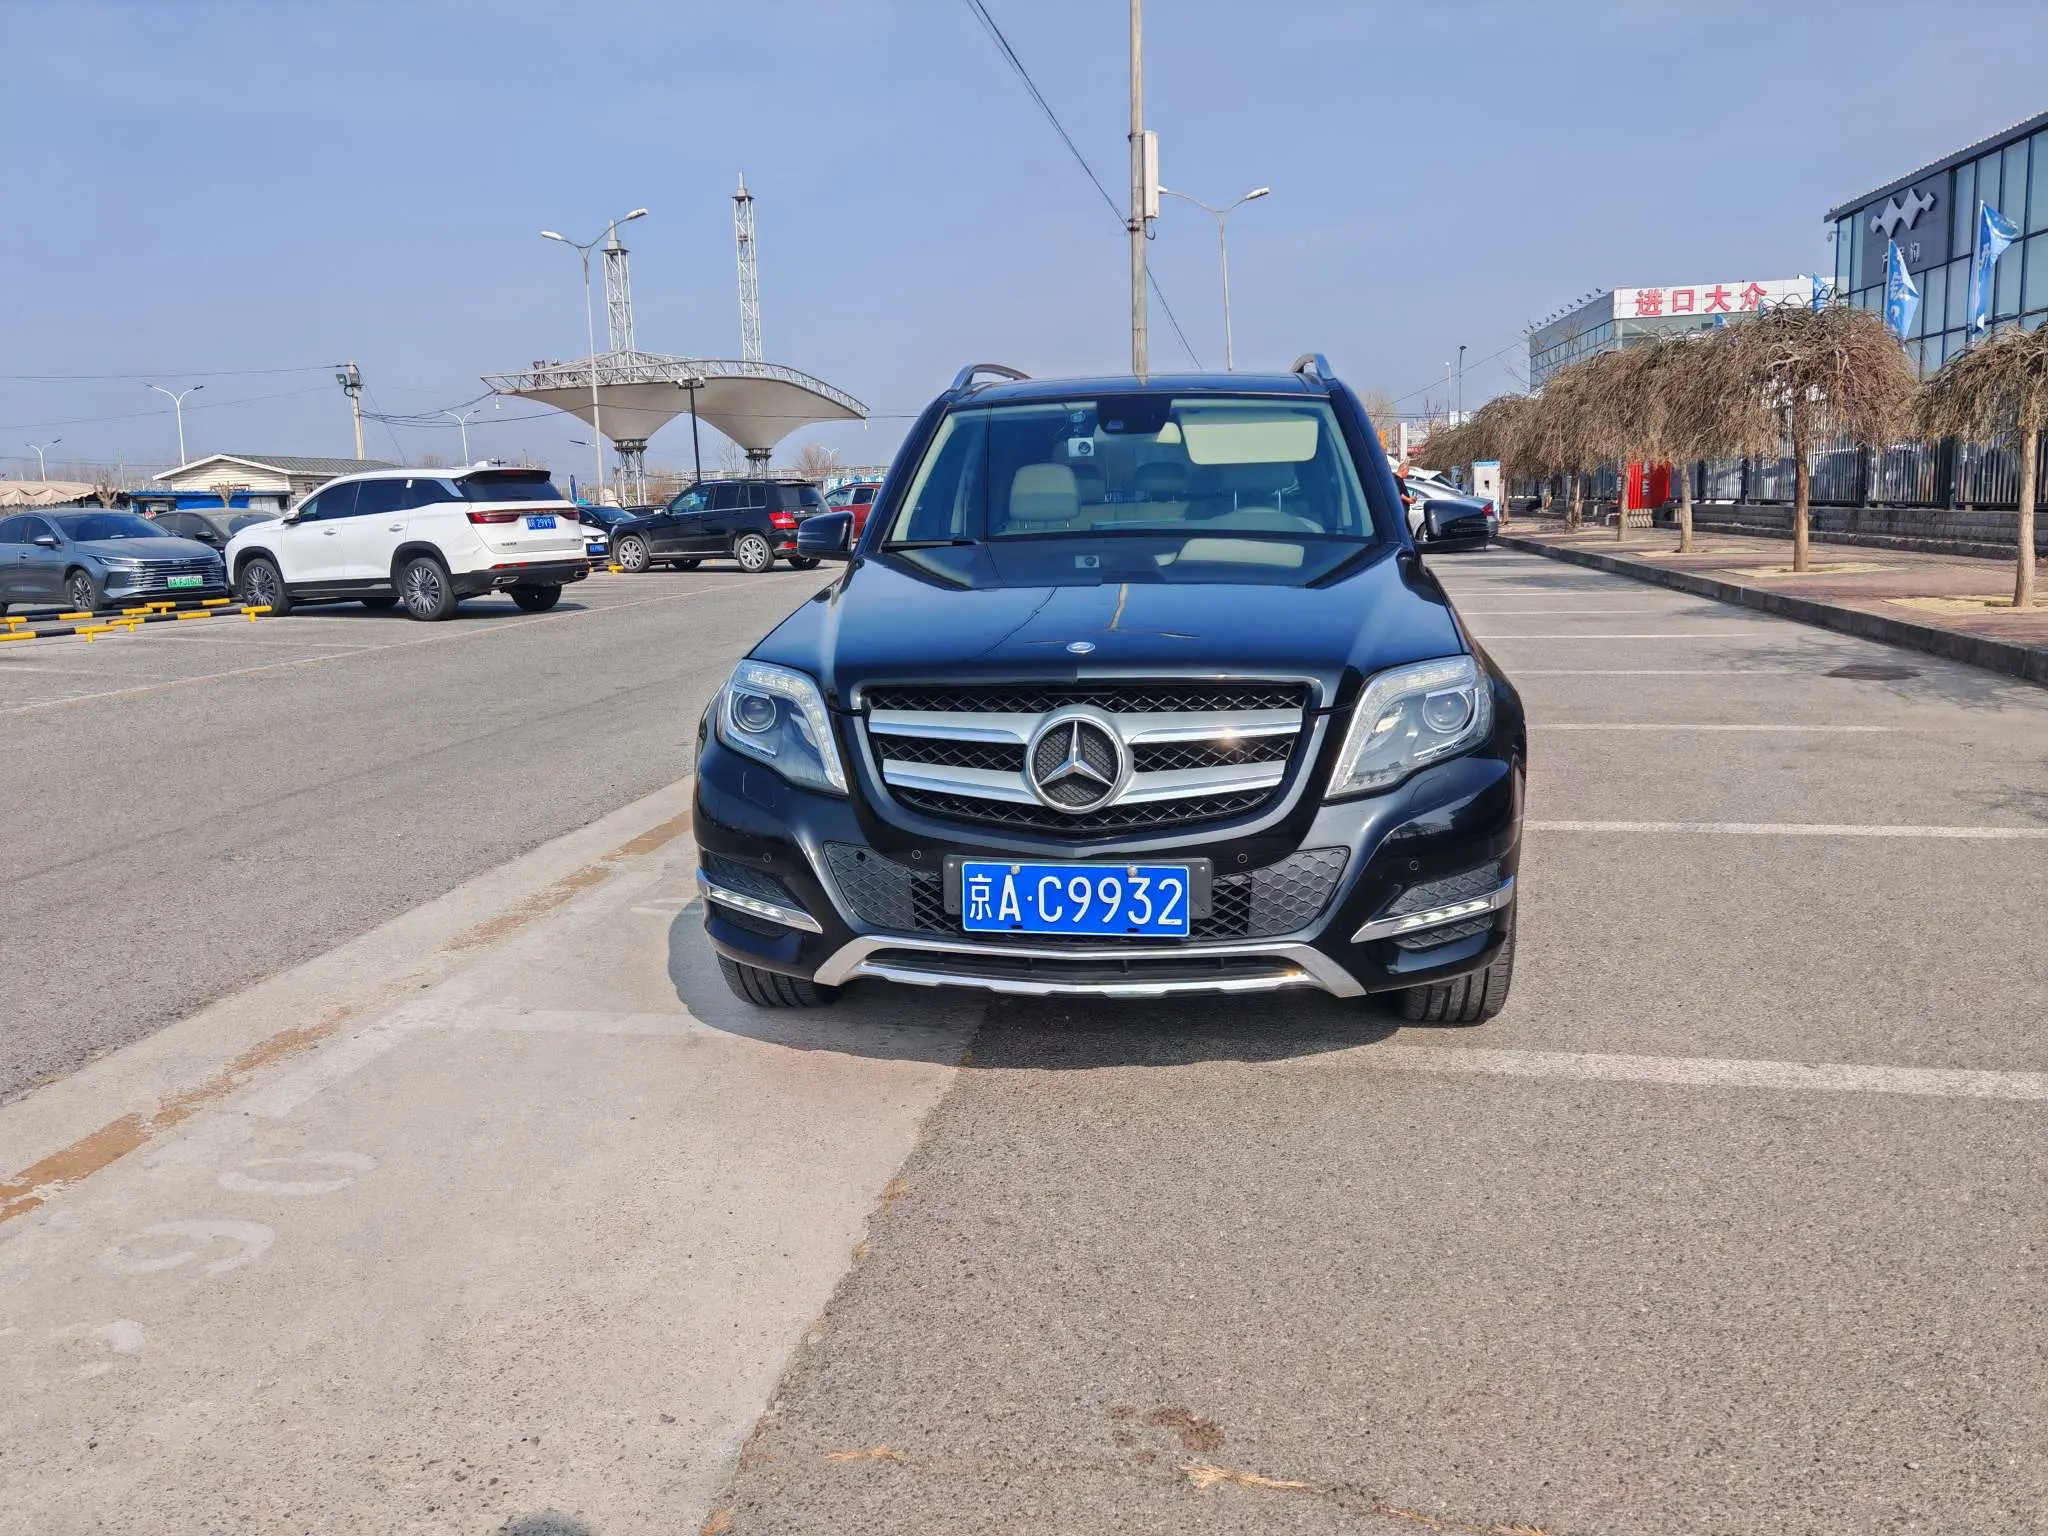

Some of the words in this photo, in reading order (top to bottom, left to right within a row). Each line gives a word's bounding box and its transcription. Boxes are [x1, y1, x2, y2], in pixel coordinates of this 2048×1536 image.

[1635, 282, 1767, 317] 进口大众
[969, 874, 1183, 925] 京A·C9932
